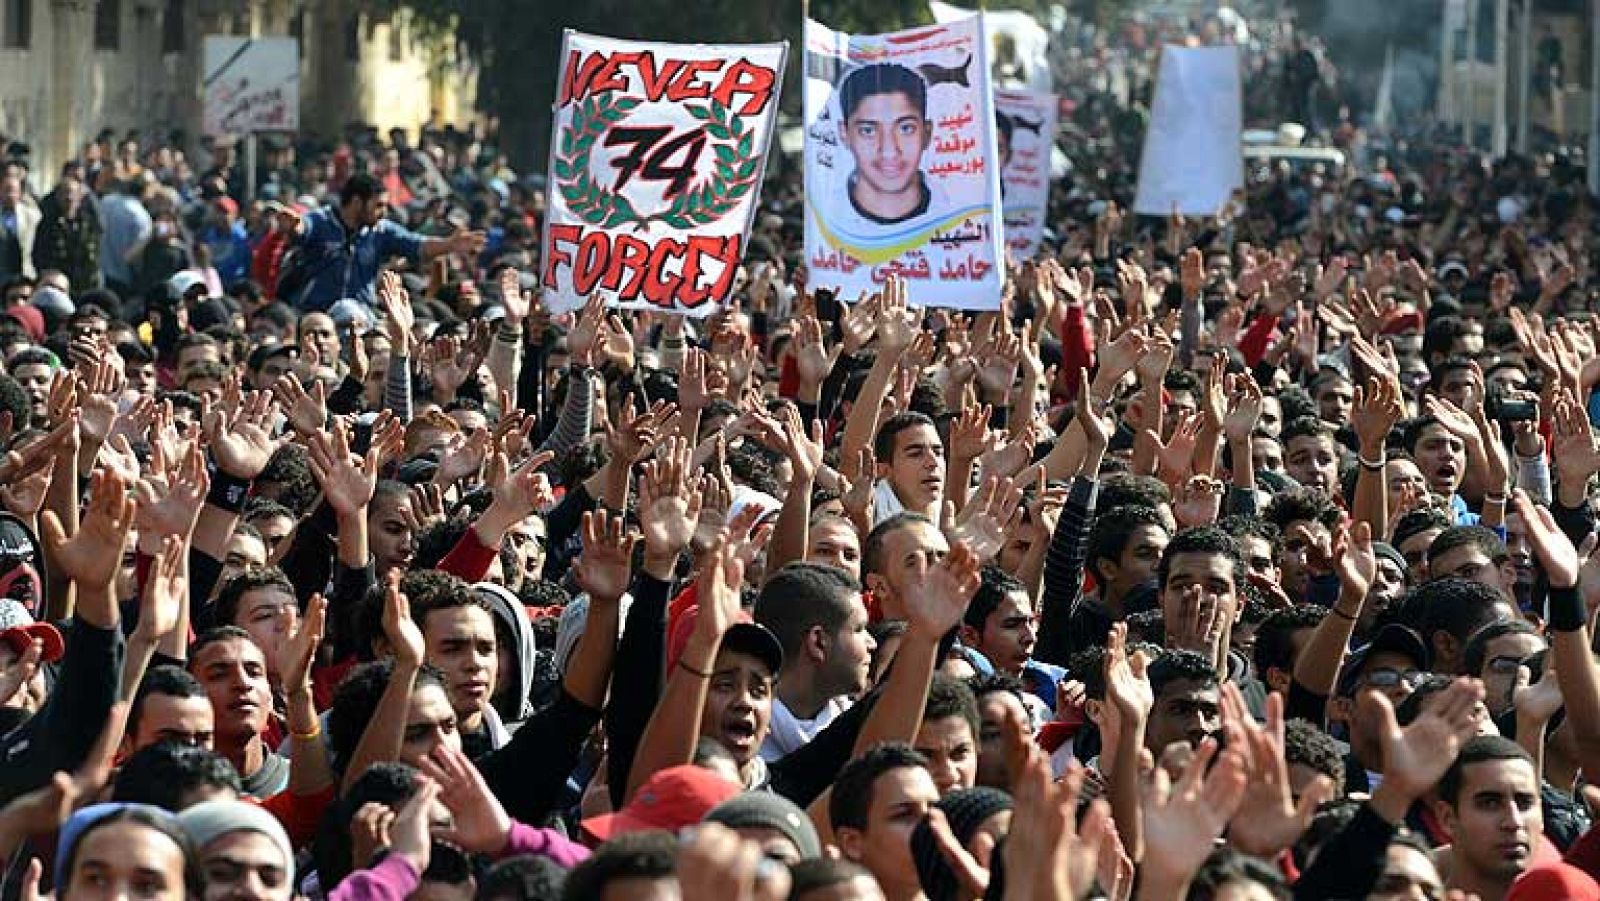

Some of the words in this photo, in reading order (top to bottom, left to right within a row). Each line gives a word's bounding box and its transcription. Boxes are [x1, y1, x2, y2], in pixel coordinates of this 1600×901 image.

[561, 50, 775, 116] NEVER
[938, 104, 973, 129] شهيد
[934, 134, 976, 154] موقعة
[604, 127, 706, 200] 74
[928, 156, 985, 178] بورسعيد
[930, 218, 990, 249] الشهيد
[812, 244, 862, 272] حامد
[939, 252, 992, 280] حامد
